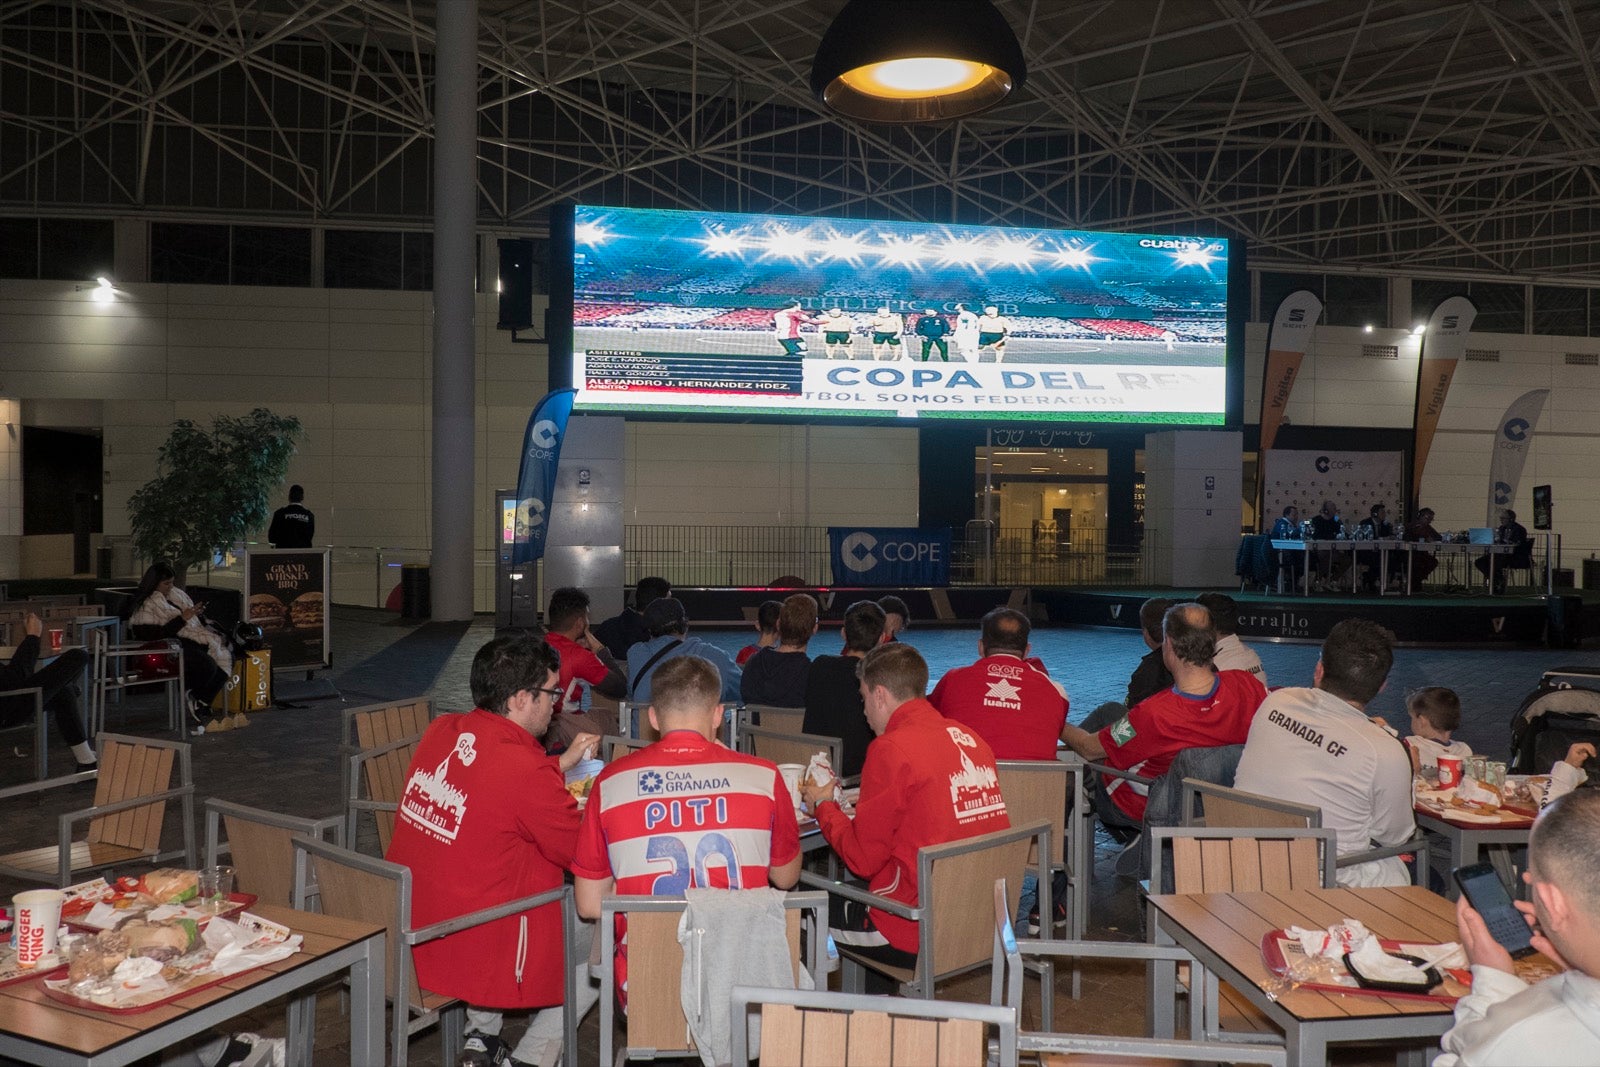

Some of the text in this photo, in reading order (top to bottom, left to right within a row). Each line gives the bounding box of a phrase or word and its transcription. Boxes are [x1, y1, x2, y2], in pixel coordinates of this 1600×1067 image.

[588, 378, 662, 386] ALEJANDRO
[679, 380, 753, 389] HERNÁNDEZ
[755, 382, 791, 390] HDEZ.
[826, 366, 983, 389] COPA
[1000, 370, 1105, 391] DEL
[1271, 367, 1294, 408] Vigilsa
[1426, 374, 1448, 416] Vigilsa
[877, 393, 964, 404] SOMOS
[528, 448, 555, 462] COPE
[1330, 461, 1354, 470] COPE
[516, 526, 541, 540] COPE
[882, 541, 941, 563] COPE
[270, 563, 307, 574] GRAND
[264, 571, 312, 582] WHISKEY
[278, 580, 299, 590] BBQ
[1237, 612, 1309, 628] errallo
[1281, 627, 1309, 636] Plaza
[983, 697, 1021, 711] luanvi
[1267, 709, 1348, 757] GRANADA CF
[458, 738, 474, 760] GCF
[665, 777, 731, 792] GRANADA
[644, 796, 728, 830] PITI
[431, 813, 447, 829] 1931
[19, 908, 31, 962] BURGER
[31, 927, 44, 962] KING
